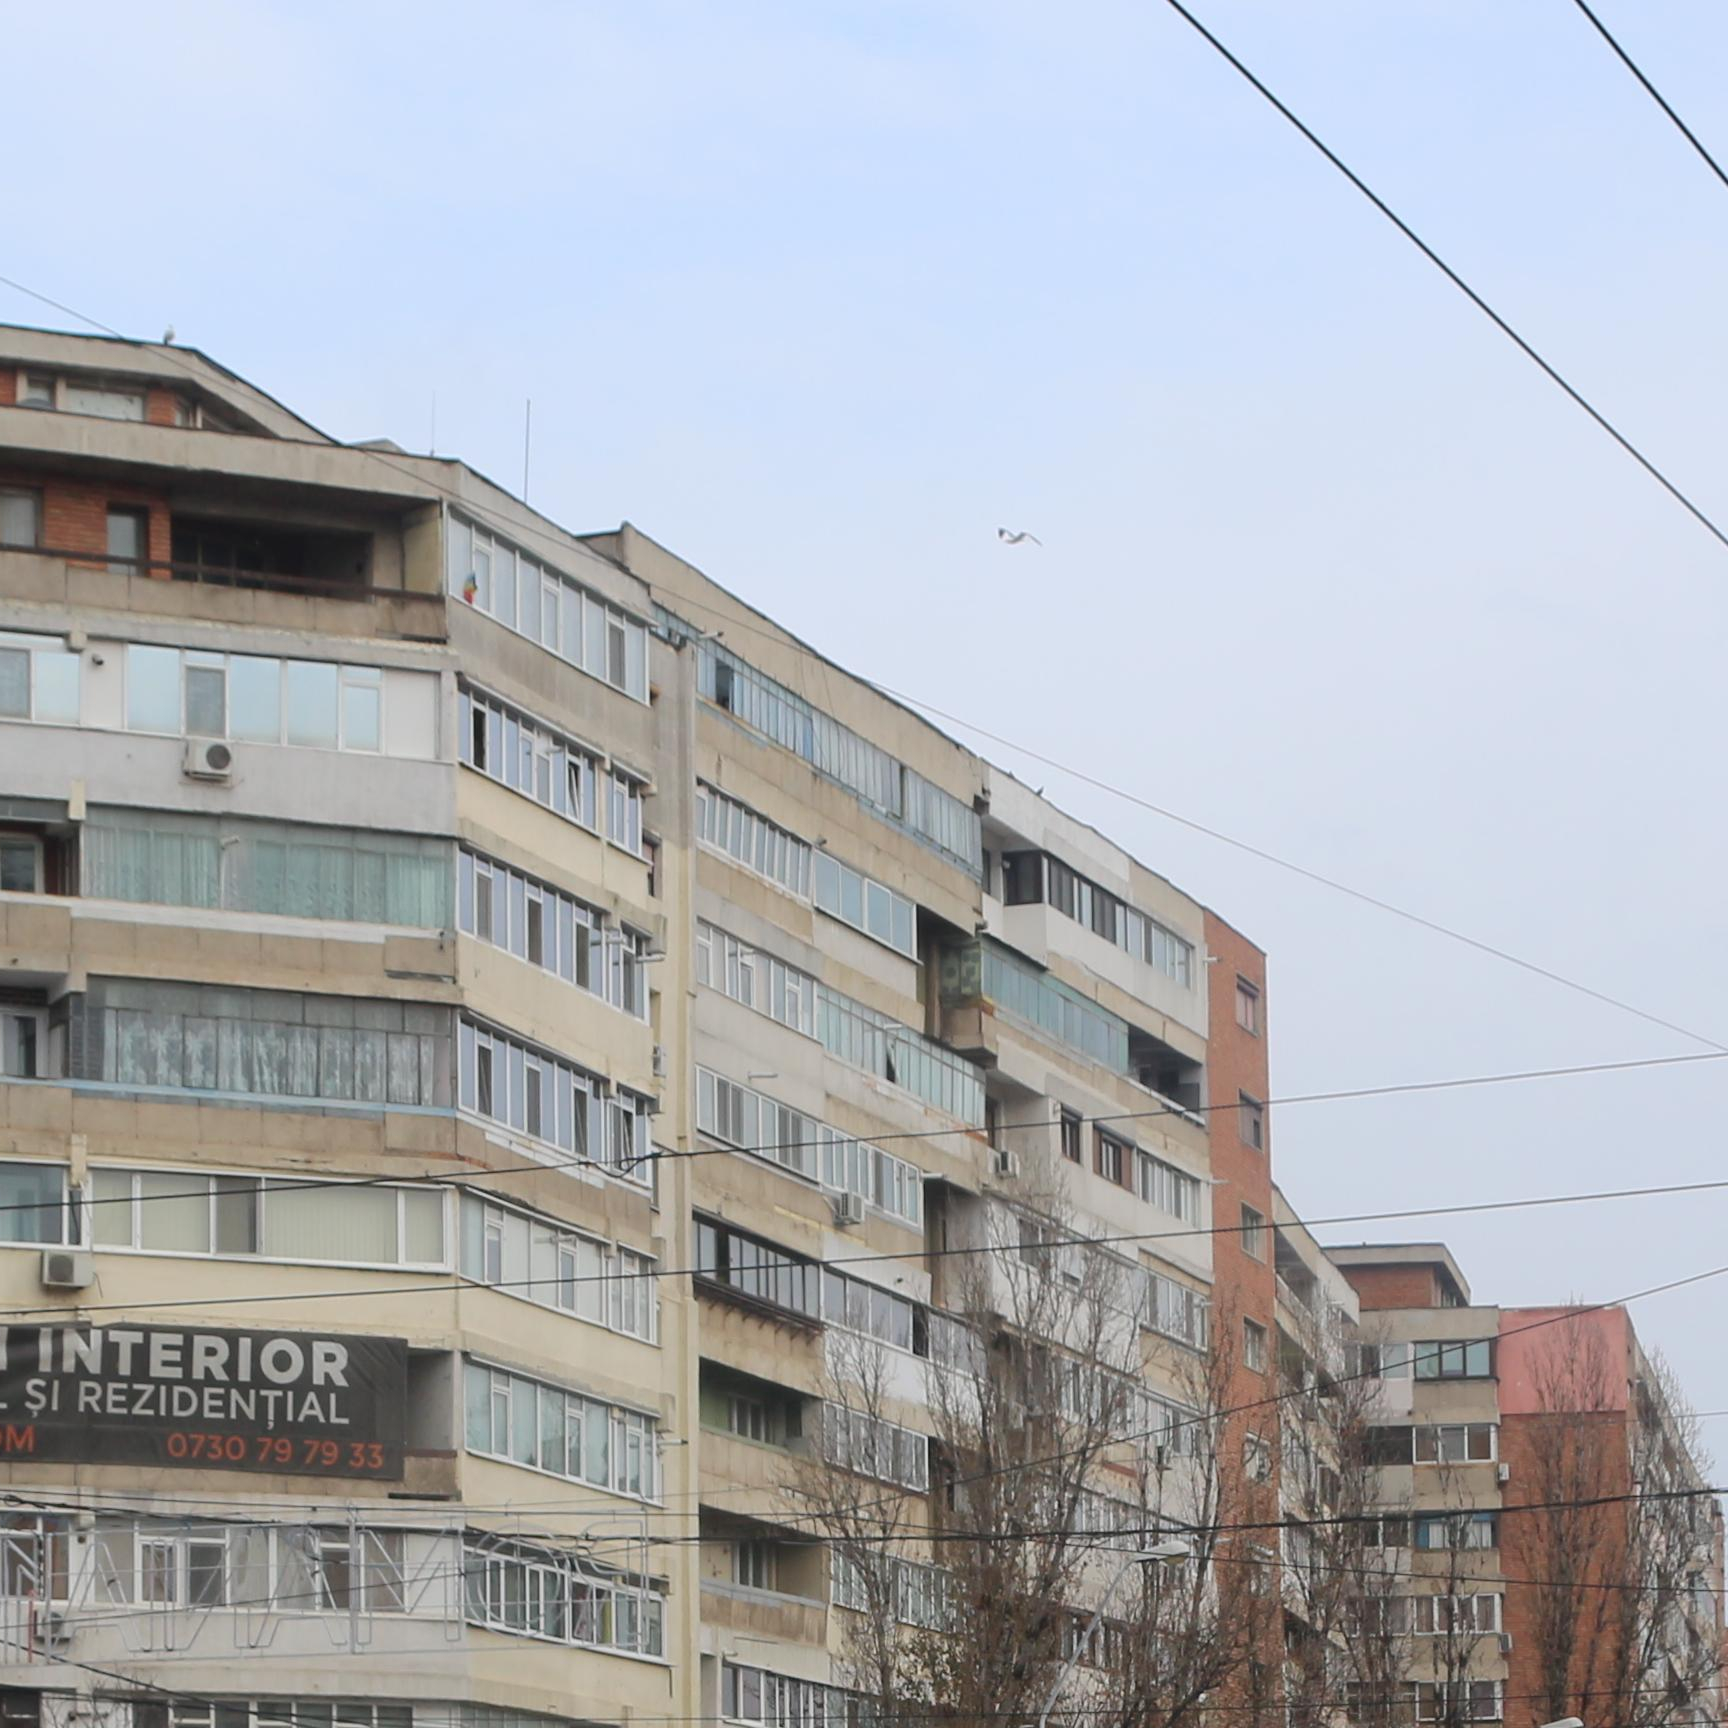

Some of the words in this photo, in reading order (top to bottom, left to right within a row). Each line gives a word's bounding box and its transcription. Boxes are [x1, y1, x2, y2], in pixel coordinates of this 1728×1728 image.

[38, 1326, 350, 1387] INTERIOR
[24, 1377, 59, 1418] ȘI
[78, 1381, 350, 1430] REZIDENȚIAL
[168, 1433, 246, 1461] 0730
[257, 1438, 293, 1463] 79
[304, 1440, 340, 1466] 79
[349, 1443, 384, 1469] 33
